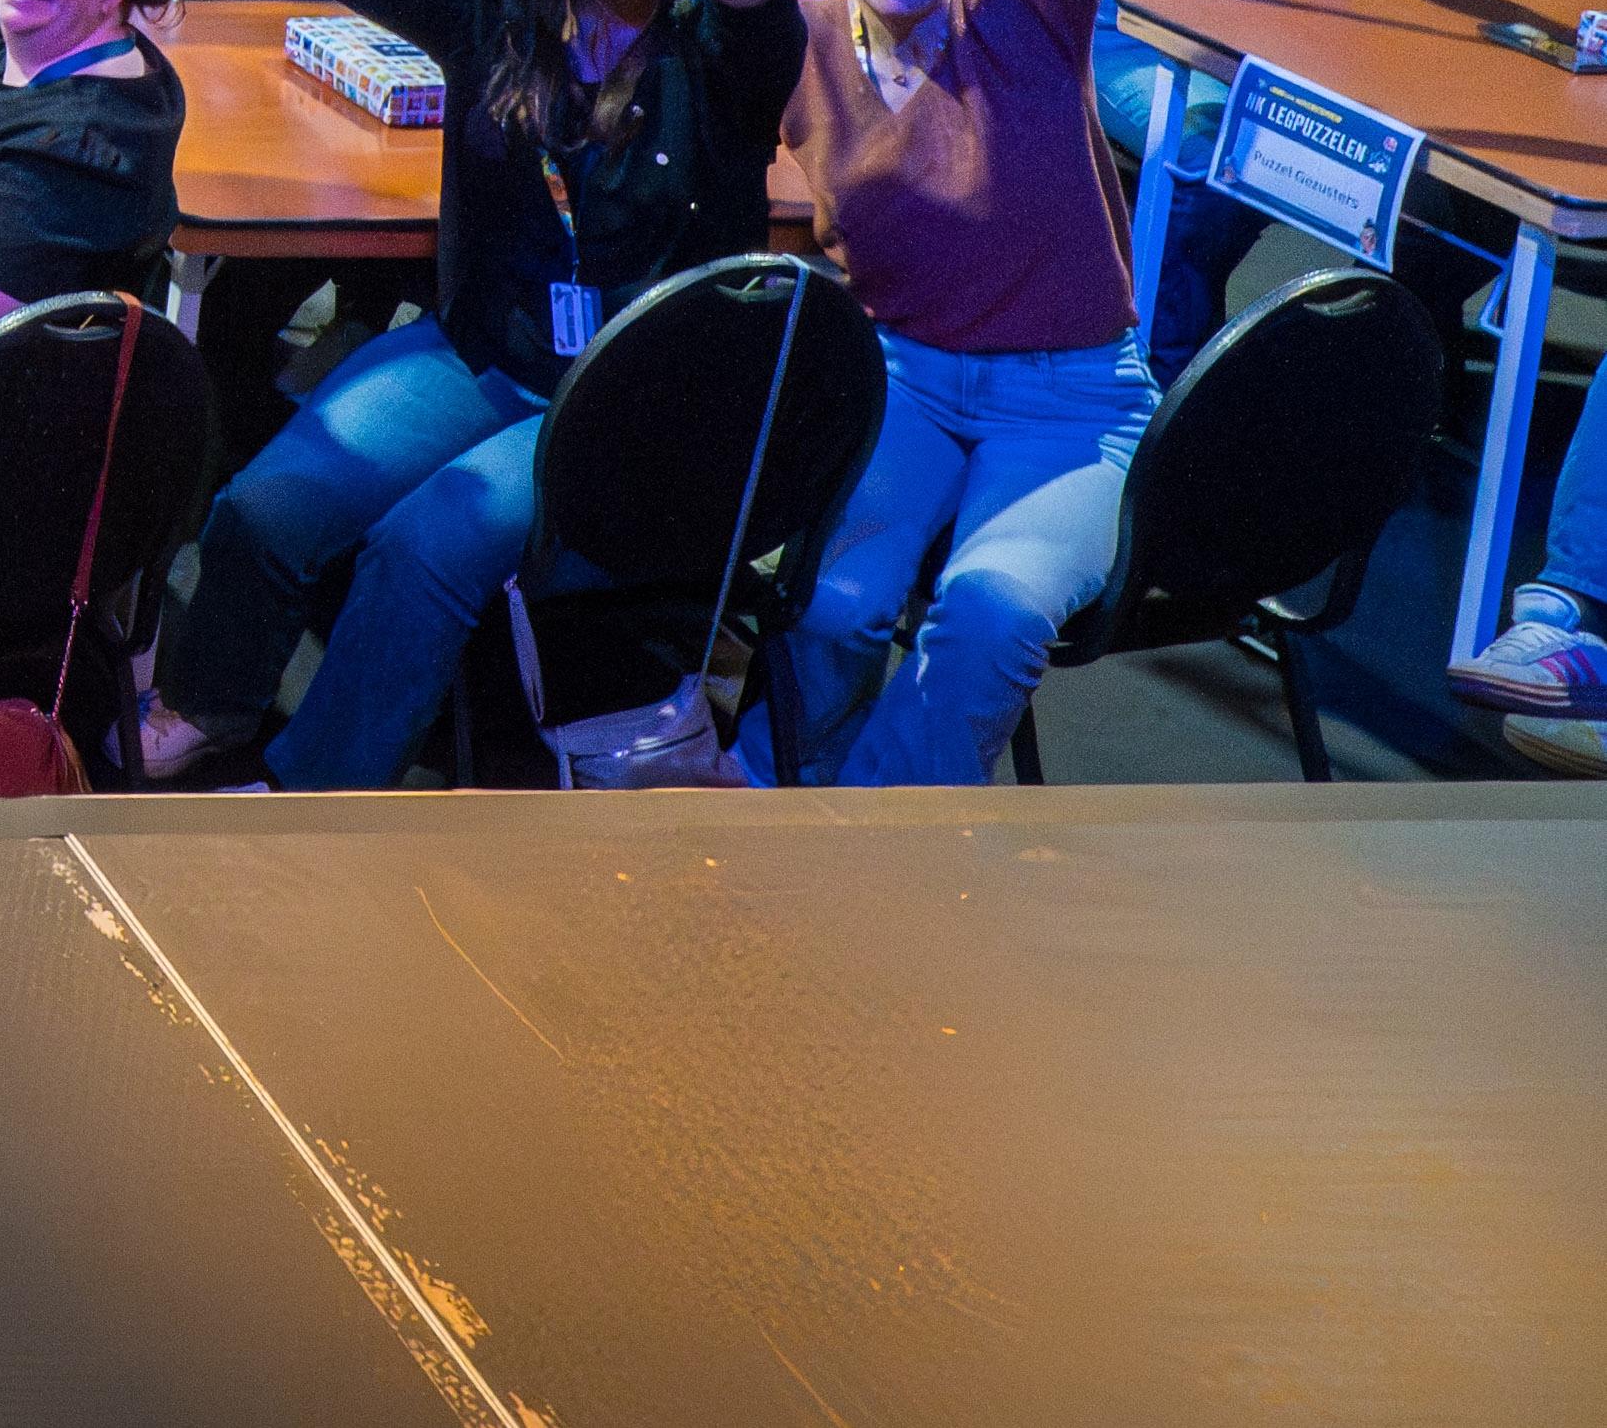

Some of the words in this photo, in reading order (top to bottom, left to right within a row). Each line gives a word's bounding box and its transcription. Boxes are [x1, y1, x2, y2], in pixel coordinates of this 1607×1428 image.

[1245, 93, 1264, 114] NK
[1268, 102, 1367, 162] LEGPUZZELEN
[1254, 151, 1292, 178] Puzzel
[1296, 169, 1359, 210] Gezusters
